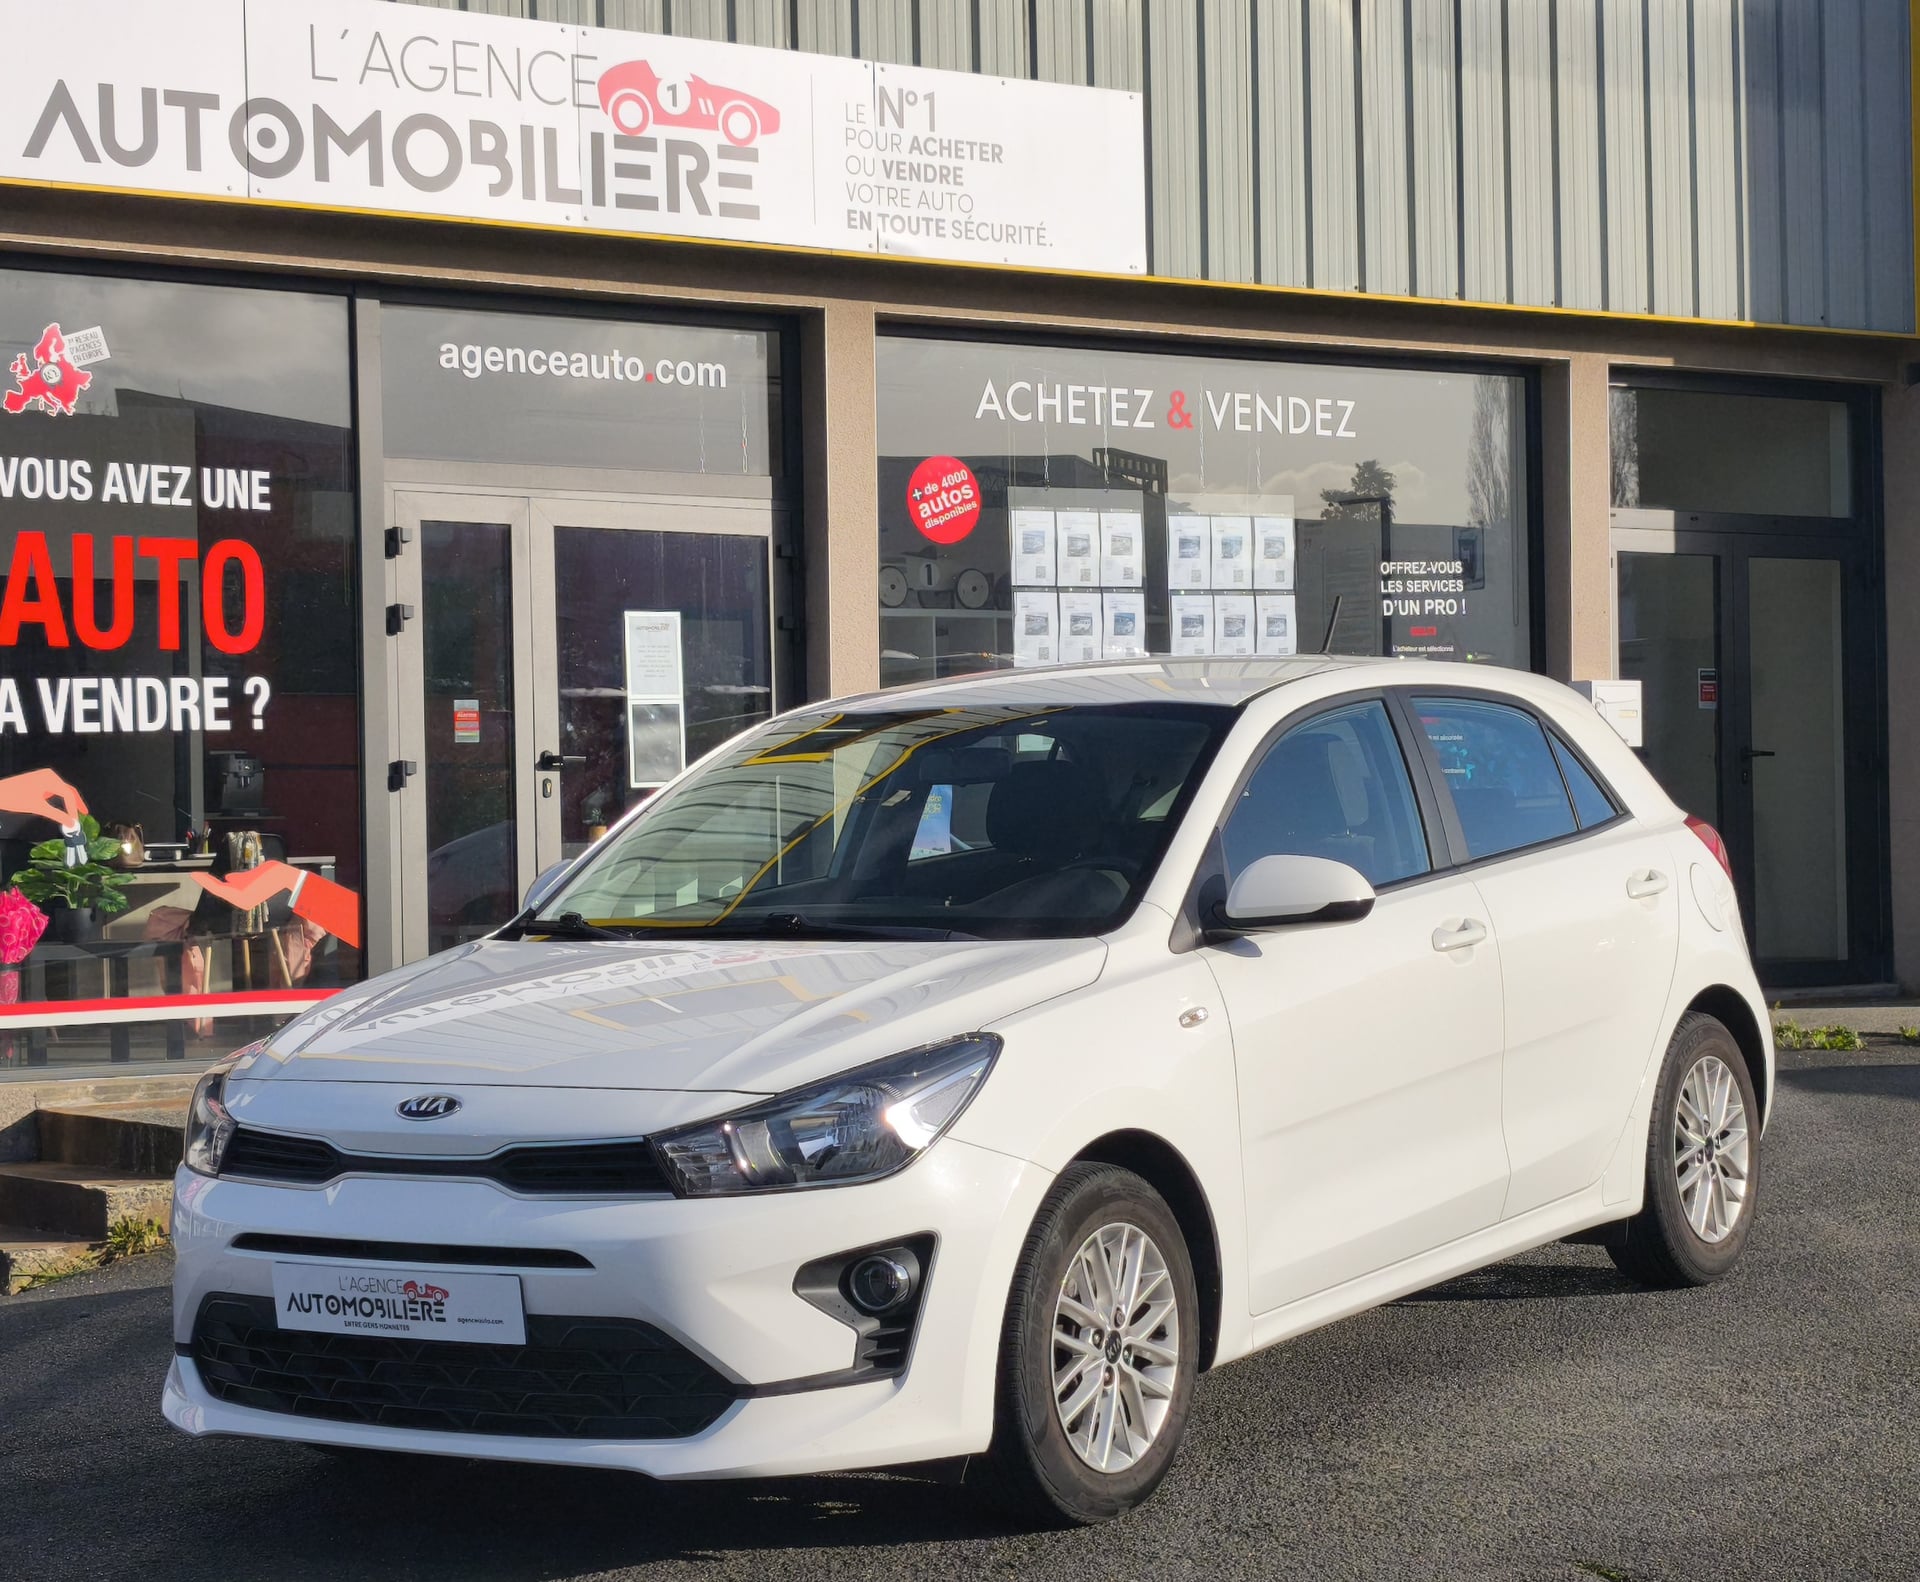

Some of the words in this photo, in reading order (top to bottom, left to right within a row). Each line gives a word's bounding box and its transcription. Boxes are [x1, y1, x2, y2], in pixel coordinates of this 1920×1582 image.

[309, 23, 600, 109] L'AGENCE
[845, 102, 866, 124] LE
[845, 127, 902, 153] POUR
[908, 135, 1003, 164] ACHETER
[845, 155, 875, 177] OU
[882, 159, 964, 187] VENDRE
[846, 182, 911, 208] VOTRE
[917, 190, 974, 214] AUTO
[847, 209, 872, 231] EN
[877, 213, 946, 239] TOUTE
[951, 215, 1053, 248] SÉCURITÉ.
[439, 343, 727, 388] agenceauto.com
[975, 378, 1155, 428] ACHETEZ
[1166, 390, 1193, 430] &
[1205, 390, 1357, 438] VENDEZ
[0, 457, 93, 501] VOUS
[101, 462, 193, 507] AVEZ
[202, 467, 271, 511] UNE
[924, 482, 939, 495] de
[941, 469, 968, 488] 4000
[918, 484, 974, 518] autos
[925, 501, 977, 529] disponibles
[1380, 561, 1463, 575] OFFREZ-VOUS
[0, 531, 264, 654] AUTO
[1381, 580, 1403, 593] LES
[1406, 579, 1464, 593] SERVICES
[1383, 599, 1420, 616] D'UN
[1424, 598, 1457, 615] PRO
[36, 677, 231, 734] VENDRE
[243, 676, 271, 731] ?
[403, 1096, 448, 1113] KIA
[338, 1275, 407, 1295] L'AGENCE
[344, 1320, 361, 1328] ENTRE
[363, 1321, 379, 1329] GENS
[457, 1317, 504, 1325] agenceauto.com
